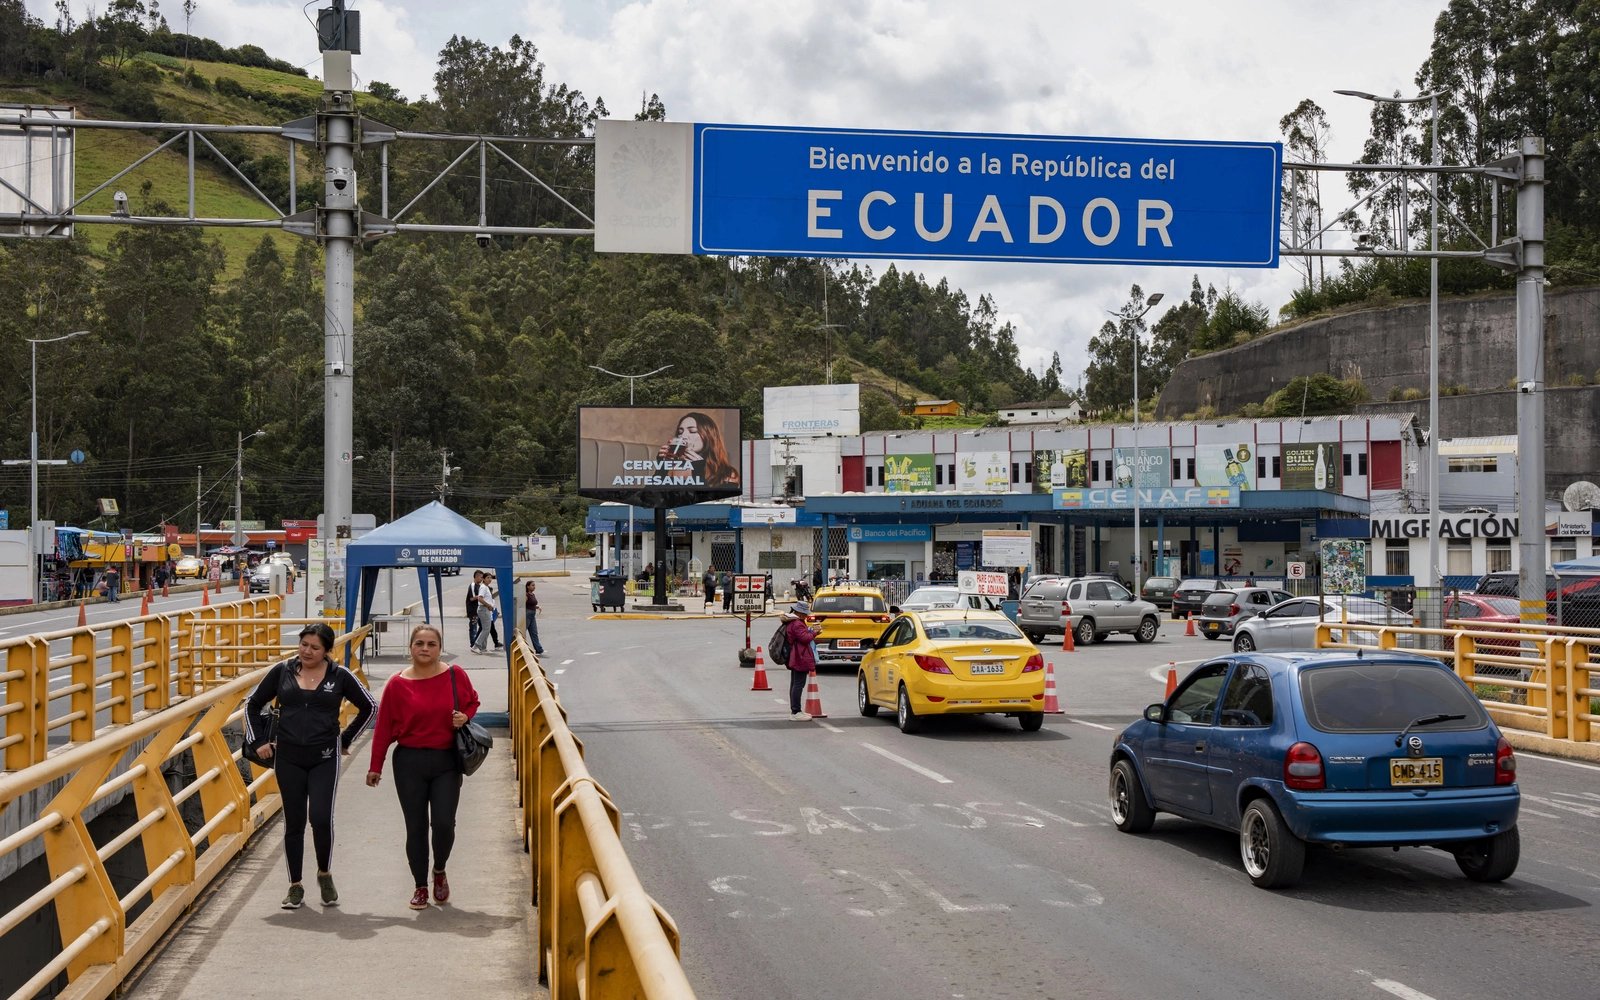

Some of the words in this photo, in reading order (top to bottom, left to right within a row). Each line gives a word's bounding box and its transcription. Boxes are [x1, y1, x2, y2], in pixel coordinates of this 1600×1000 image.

[809, 146, 949, 174] Bienvenido
[958, 156, 972, 174] a
[981, 152, 1001, 175] la
[1011, 153, 1132, 182] República
[1140, 158, 1175, 180] del
[807, 189, 1174, 247] ECUADOR
[782, 419, 839, 428] FRONTERAS
[1125, 455, 1163, 466] BLANCO
[1286, 455, 1314, 463] BULL
[622, 460, 694, 471] CERVEZA
[1139, 465, 1152, 473] QUE
[612, 475, 705, 486] ARTESANAL
[1088, 488, 1201, 503] CENAF
[911, 499, 945, 509] ADUANA
[946, 499, 961, 509] DEL
[964, 499, 1004, 509] ECUADOR
[887, 529, 898, 537] del
[417, 548, 462, 556] DESINFECCIÓN
[977, 573, 987, 583] PARE
[987, 574, 1006, 584] CONTROL
[978, 584, 985, 593] DE
[987, 585, 1006, 595] ADUANA
[971, 665, 1004, 673] CAA-1633
[1392, 764, 1415, 778] CMB
[1420, 764, 1441, 778] 415
